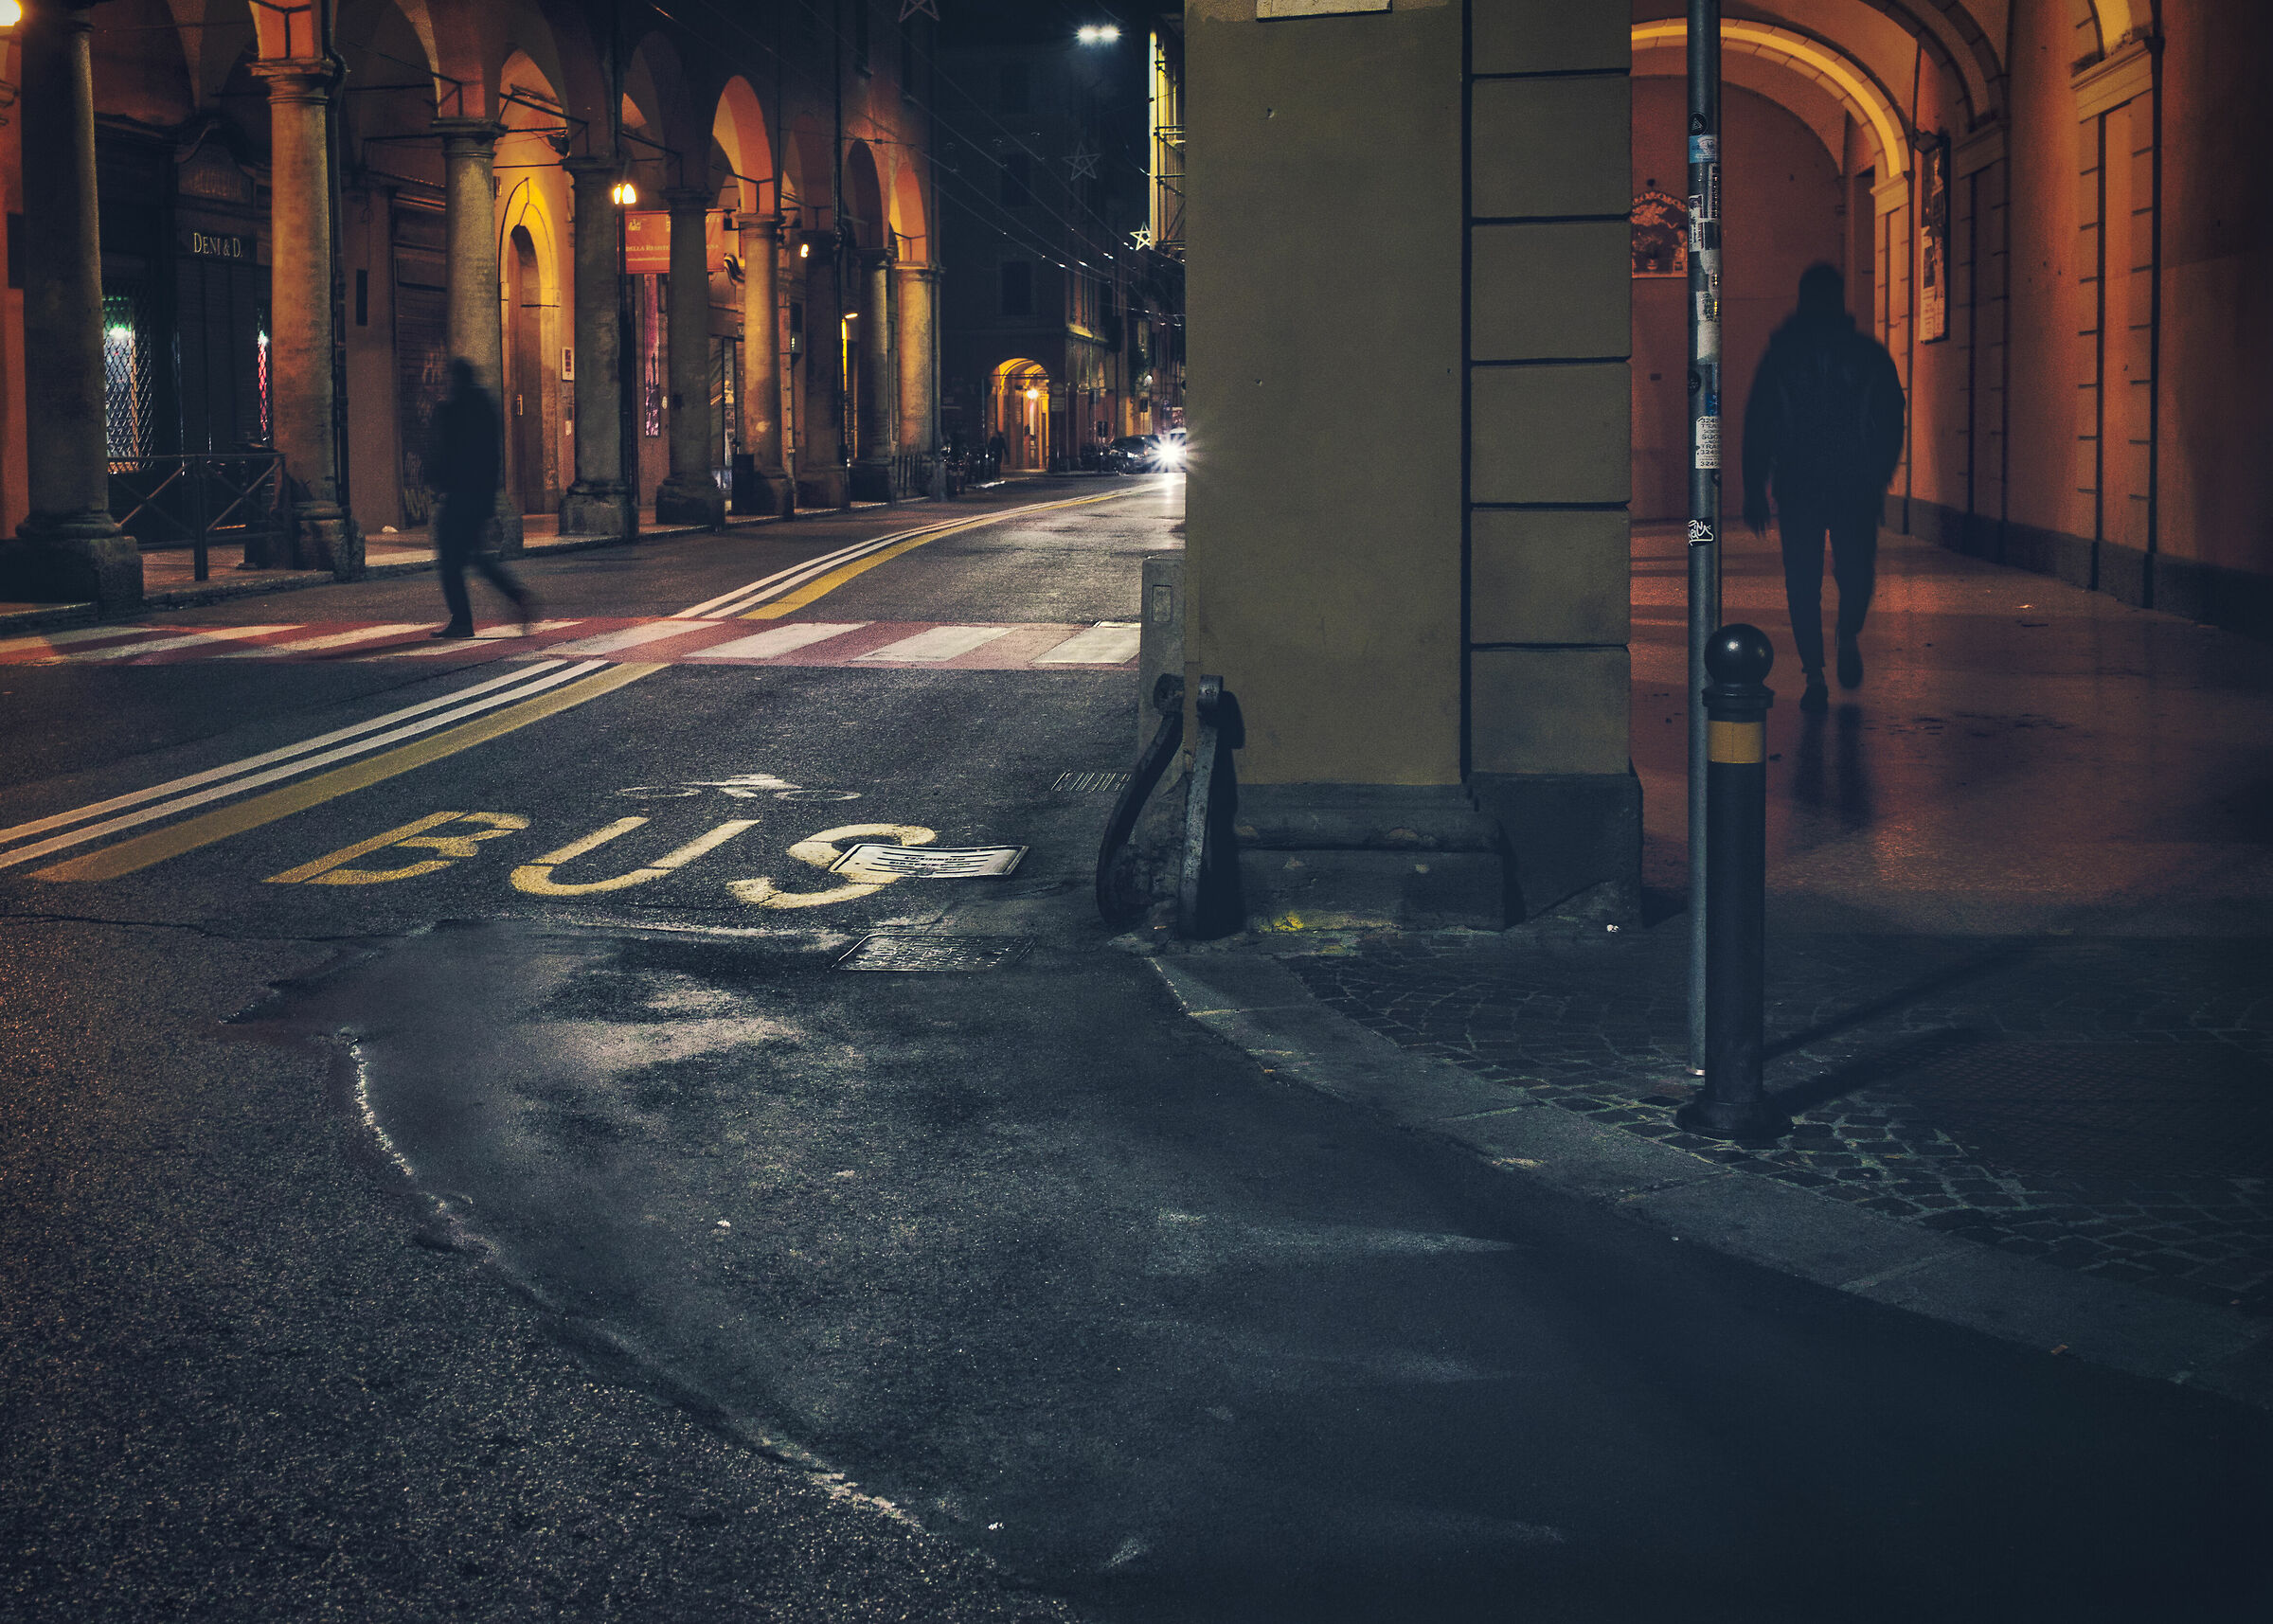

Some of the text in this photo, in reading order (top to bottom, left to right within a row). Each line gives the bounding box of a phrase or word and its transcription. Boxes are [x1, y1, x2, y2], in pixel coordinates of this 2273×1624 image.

[193, 232, 221, 256] DENI
[223, 239, 231, 256] &
[261, 811, 938, 909] BUS
